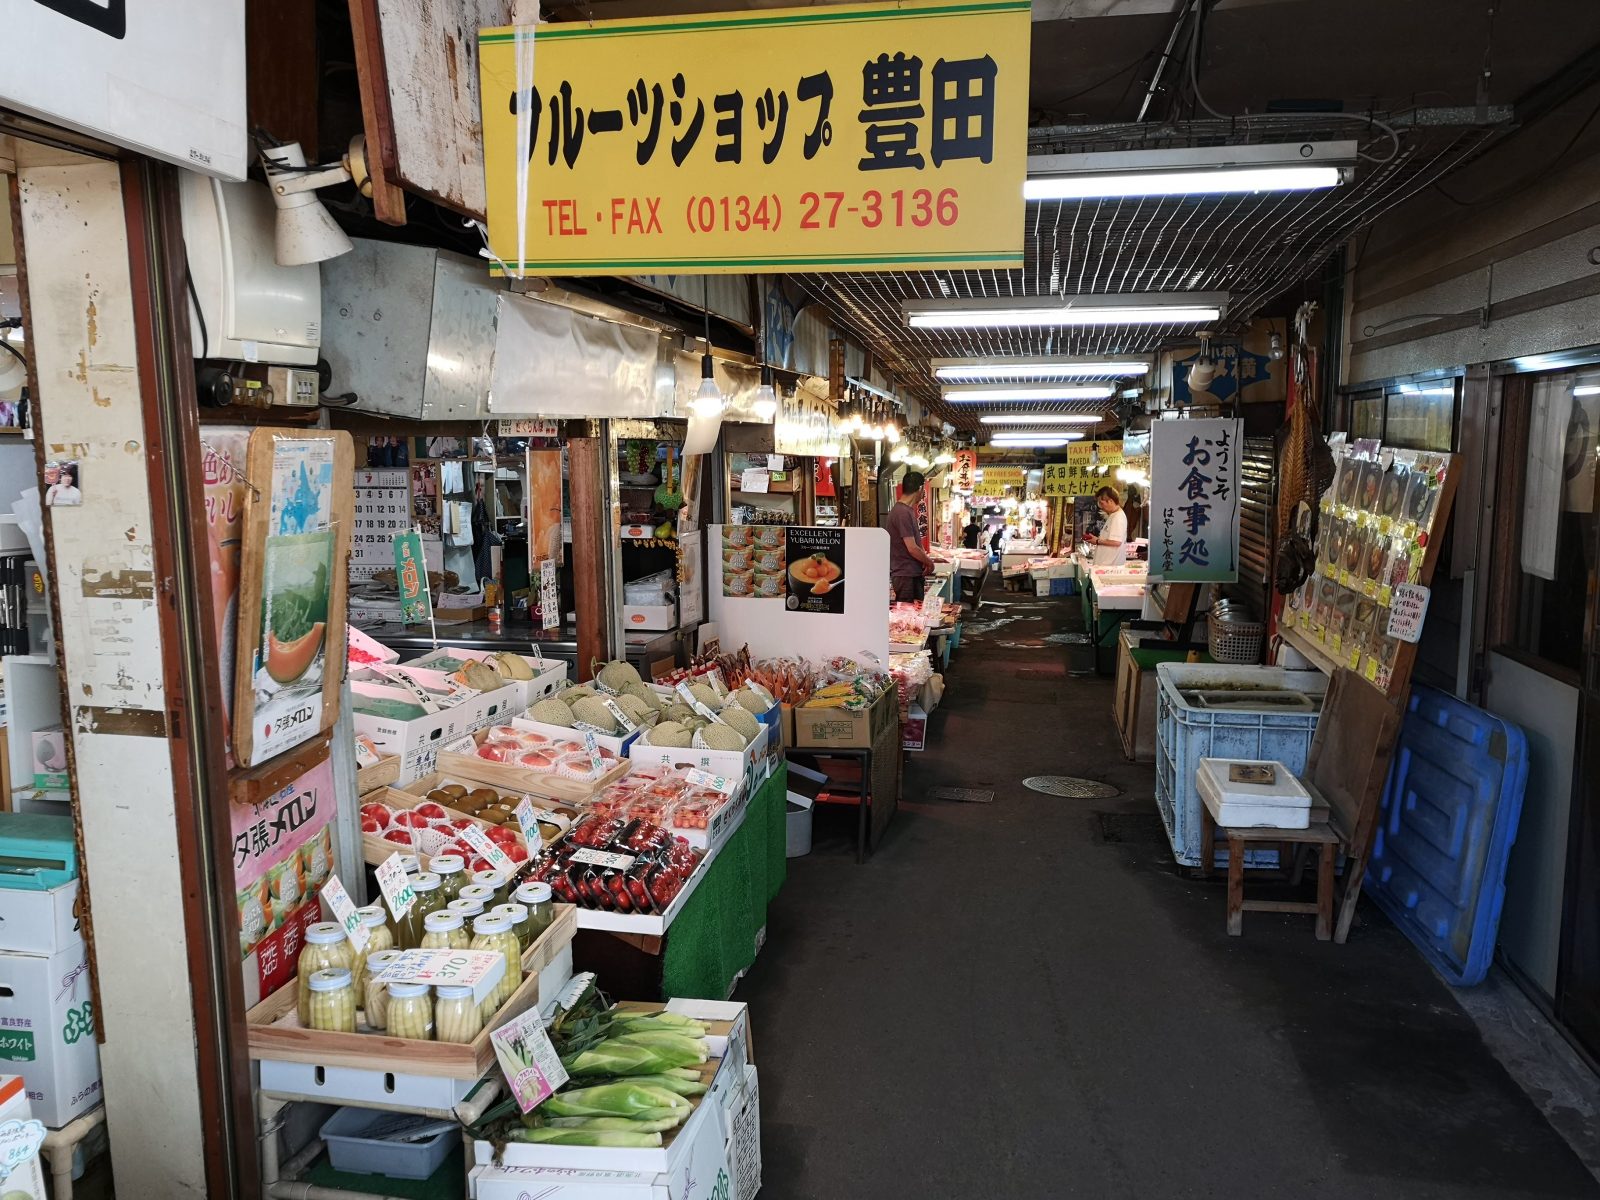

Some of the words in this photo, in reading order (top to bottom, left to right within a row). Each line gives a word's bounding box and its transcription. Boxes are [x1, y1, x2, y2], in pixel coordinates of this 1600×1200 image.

[509, 71, 835, 171] フルーツショップ
[857, 51, 998, 171] 豊田
[686, 194, 783, 236] (0134)
[799, 187, 960, 231] 27-3136
[1070, 457, 1090, 465] TAKEDA
[1212, 430, 1231, 501] ようこそ
[355, 490, 360, 498] 3
[367, 490, 372, 498] 4
[378, 490, 383, 498] 5
[388, 490, 393, 498] 6
[400, 490, 404, 498] 7
[1177, 434, 1213, 567] お食事処
[354, 505, 362, 513] 10
[366, 505, 373, 513] 11
[377, 505, 384, 513] 12
[388, 505, 395, 513] 13
[399, 505, 406, 513] 14
[355, 520, 362, 528] 17
[366, 520, 374, 528] 18
[377, 520, 385, 528] 19
[388, 520, 396, 528] 20
[399, 520, 407, 528] 21
[354, 535, 363, 543] 24
[366, 535, 374, 543] 25
[377, 535, 385, 543] 26
[790, 529, 833, 538] EXCELLENT
[790, 536, 815, 544] YUBARI
[815, 537, 841, 545] MELON
[1162, 508, 1174, 572] はやしや食堂
[401, 558, 419, 598] メロン
[274, 705, 315, 734] 夕張メロン
[662, 754, 670, 763] 共
[233, 788, 318, 869] 夕張メロン
[486, 847, 504, 864] 160
[436, 957, 468, 979] 370
[25, 1091, 44, 1101] 組合
